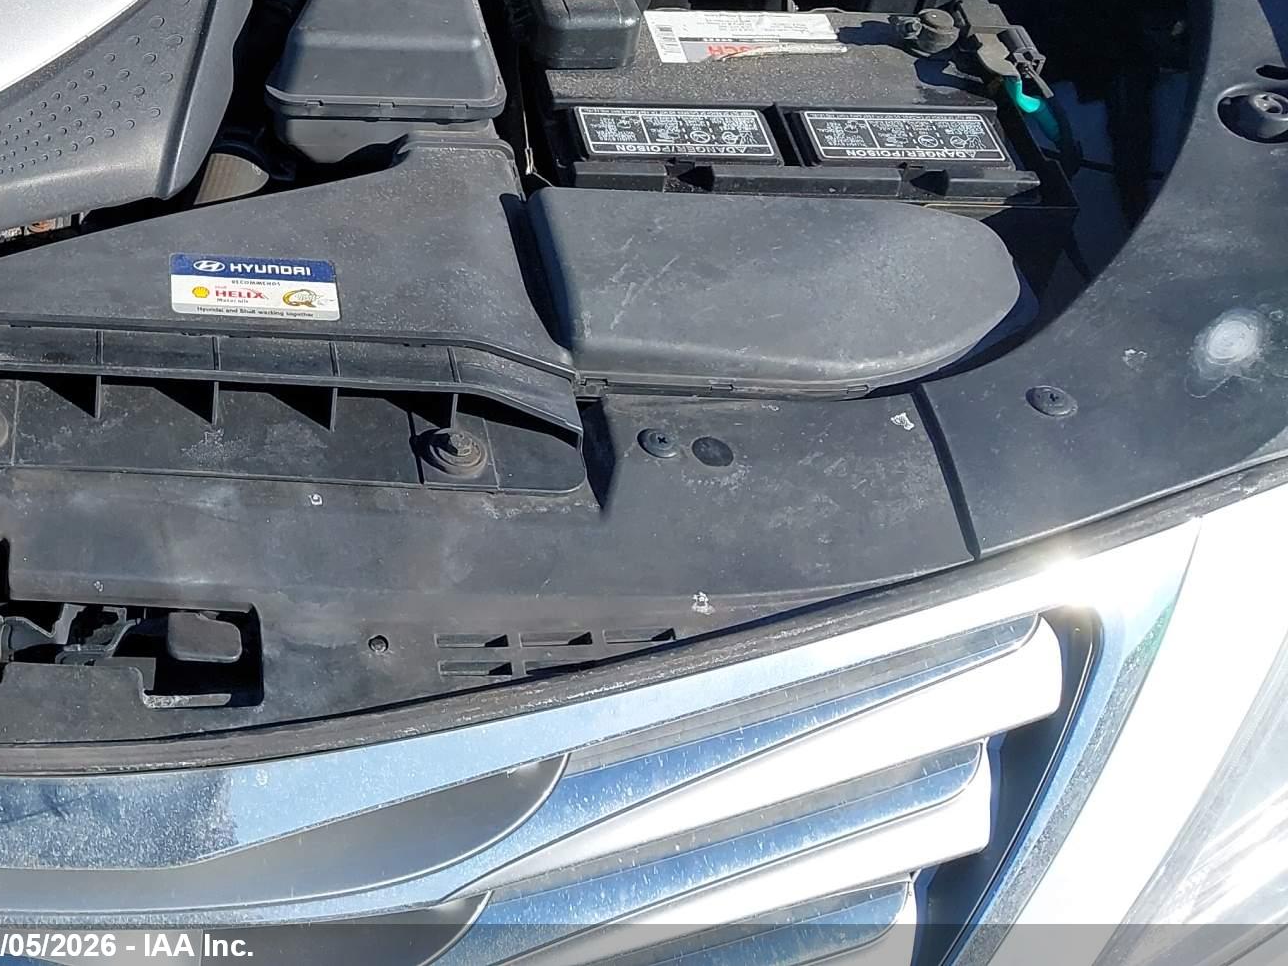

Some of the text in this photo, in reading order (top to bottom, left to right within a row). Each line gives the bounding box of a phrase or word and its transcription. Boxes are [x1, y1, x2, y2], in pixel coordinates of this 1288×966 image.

[616, 143, 737, 155] DANGER/POISON
[846, 149, 967, 160] DANGER/POISON
[229, 262, 312, 276] HYUNDAI
[214, 289, 266, 300] HELIX
